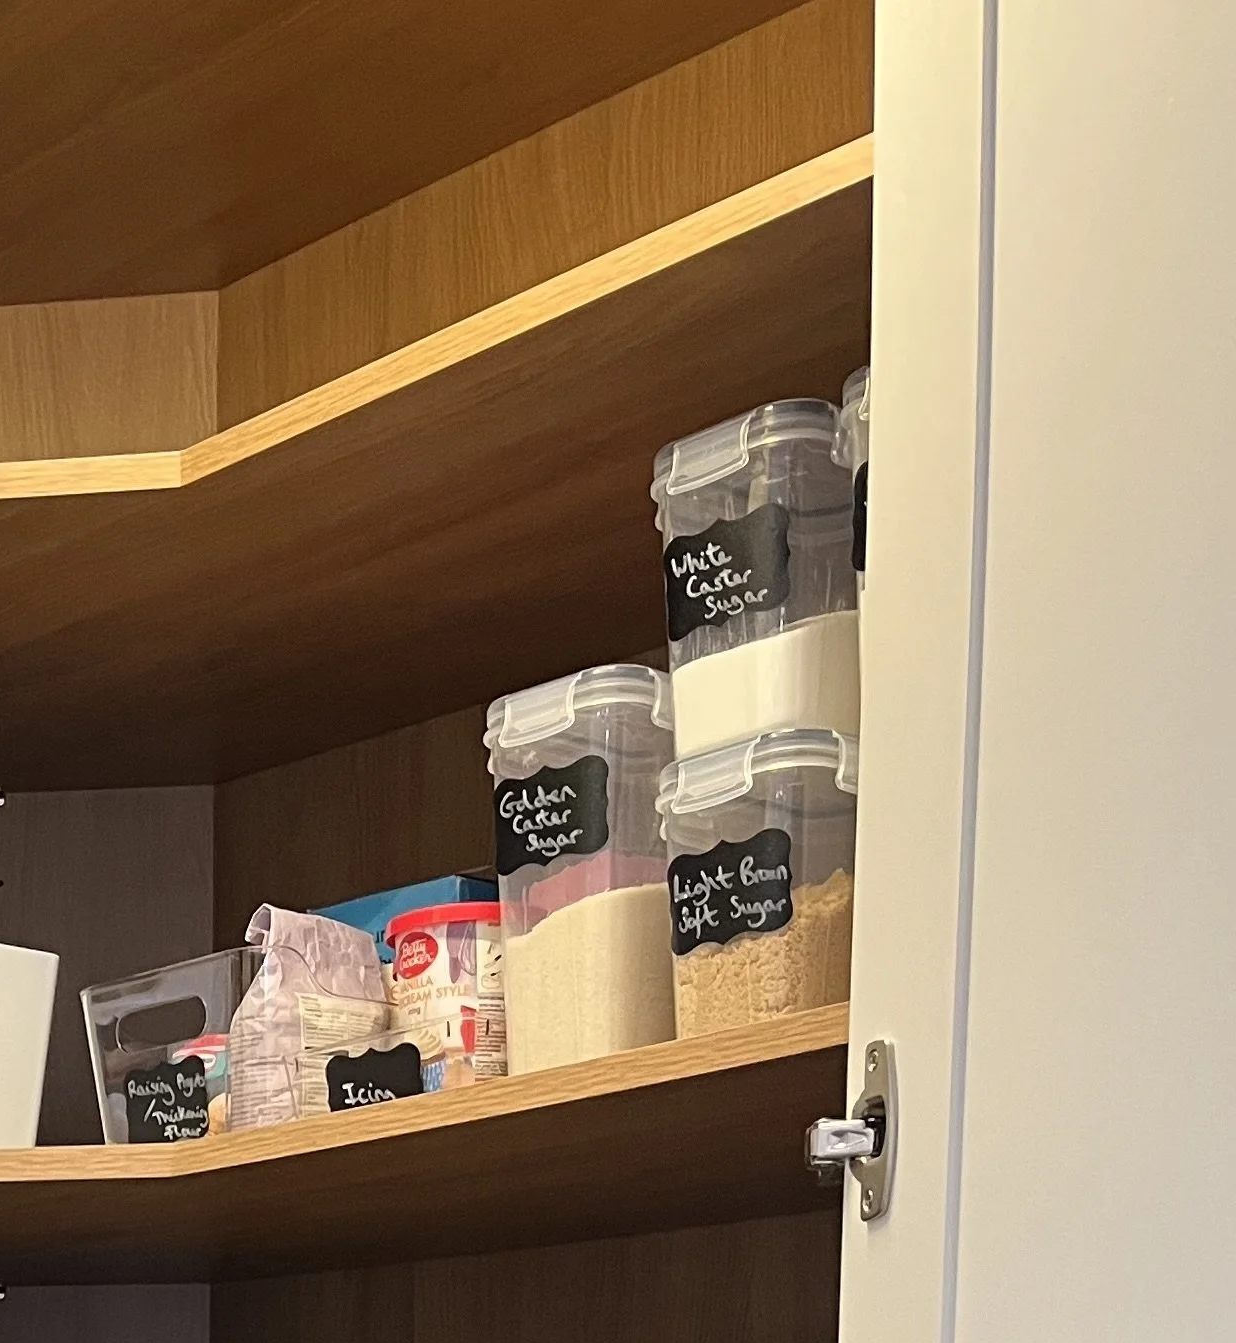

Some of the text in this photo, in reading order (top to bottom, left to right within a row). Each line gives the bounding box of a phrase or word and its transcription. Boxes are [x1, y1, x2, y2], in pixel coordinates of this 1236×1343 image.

[671, 542, 732, 578] White
[686, 569, 752, 598] Caster
[704, 588, 768, 620] Sugar
[500, 785, 577, 818] Golden
[513, 809, 572, 835] Caster
[526, 829, 583, 857] Sugar
[673, 865, 734, 906] Light
[678, 895, 787, 939] Soft Sugar
[128, 1076, 175, 1106] Raising
